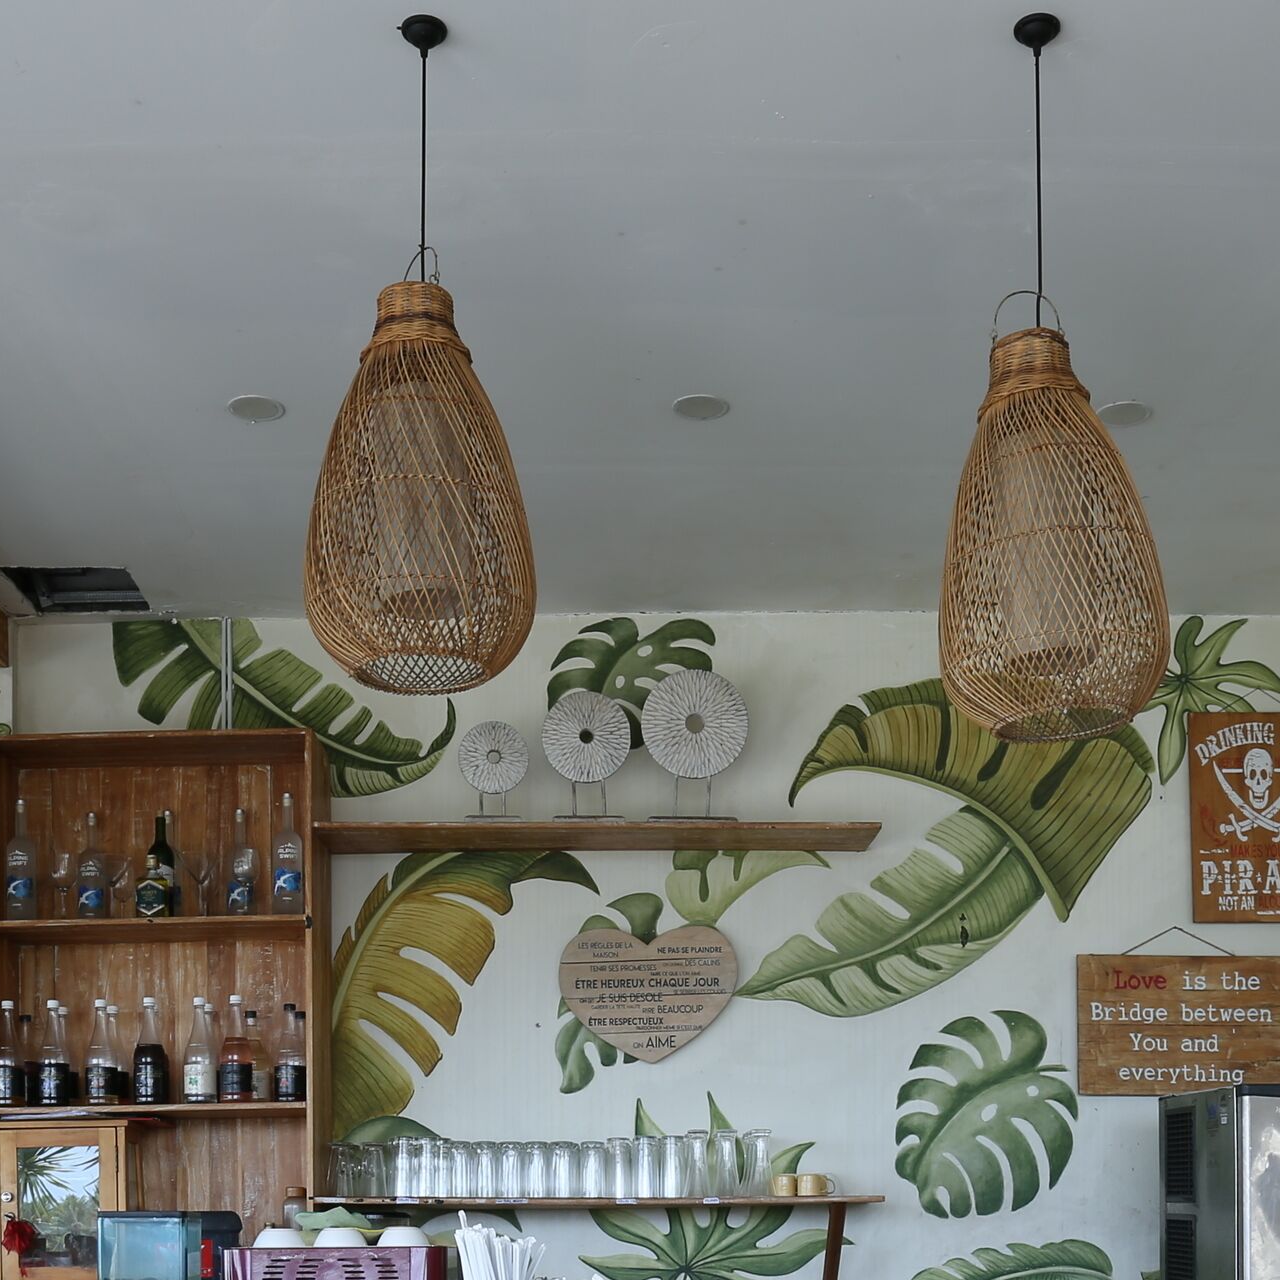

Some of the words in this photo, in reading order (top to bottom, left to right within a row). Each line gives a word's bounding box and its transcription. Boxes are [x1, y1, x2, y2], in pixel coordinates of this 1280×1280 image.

[1194, 722, 1275, 766] DRINKING
[1218, 896, 1239, 911] NOT
[1240, 896, 1255, 911] AN
[615, 941, 623, 949] DE
[624, 941, 633, 949] LA
[667, 946, 680, 954] PAS
[620, 964, 657, 972] PROMESSES
[601, 978, 645, 989] HEUREUX
[648, 977, 690, 988] CHAQUE
[692, 977, 720, 987] JOUR
[1113, 970, 1167, 990] Love
[1182, 970, 1207, 990] is
[1220, 971, 1261, 990] the
[596, 994, 606, 1003] JE
[609, 993, 627, 1003] SUIS
[657, 1005, 704, 1014] BEAUCOUP
[1090, 1002, 1168, 1024] Bridge
[1180, 1003, 1272, 1023] between
[609, 1017, 664, 1026] RESPECTUEUX
[646, 1035, 677, 1048] AIME
[1130, 1033, 1168, 1051] You
[1180, 1034, 1219, 1052] and
[1119, 1064, 1245, 1085] everything
